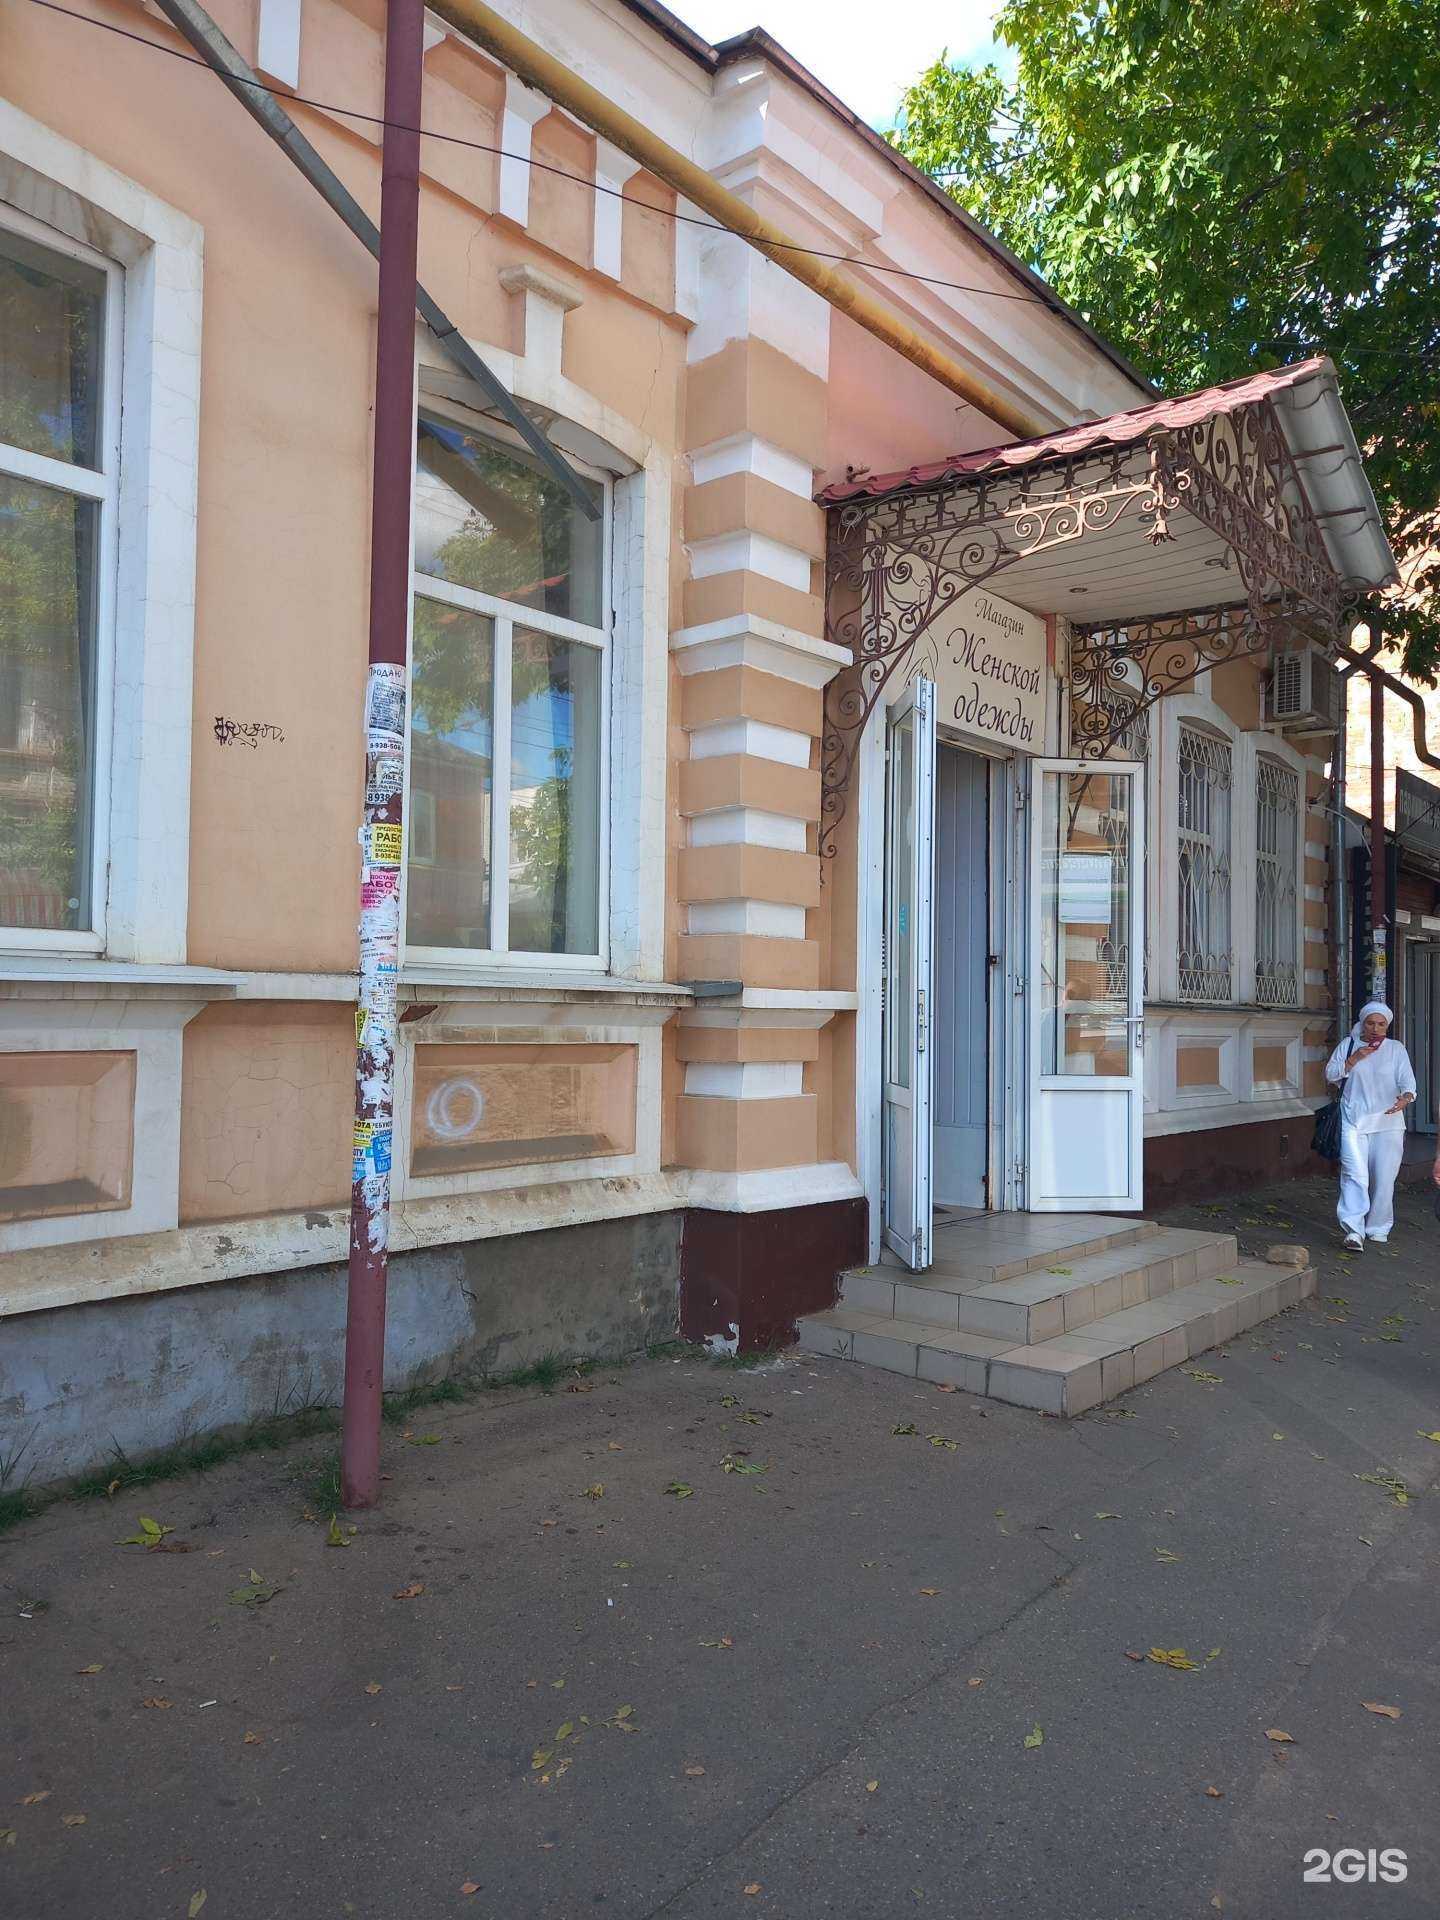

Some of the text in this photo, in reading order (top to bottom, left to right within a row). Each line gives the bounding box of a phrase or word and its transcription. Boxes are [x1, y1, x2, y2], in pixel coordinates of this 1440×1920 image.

[975, 599, 1024, 638] Магазин
[946, 628, 1040, 695] Женской
[953, 682, 1034, 742] одежды
